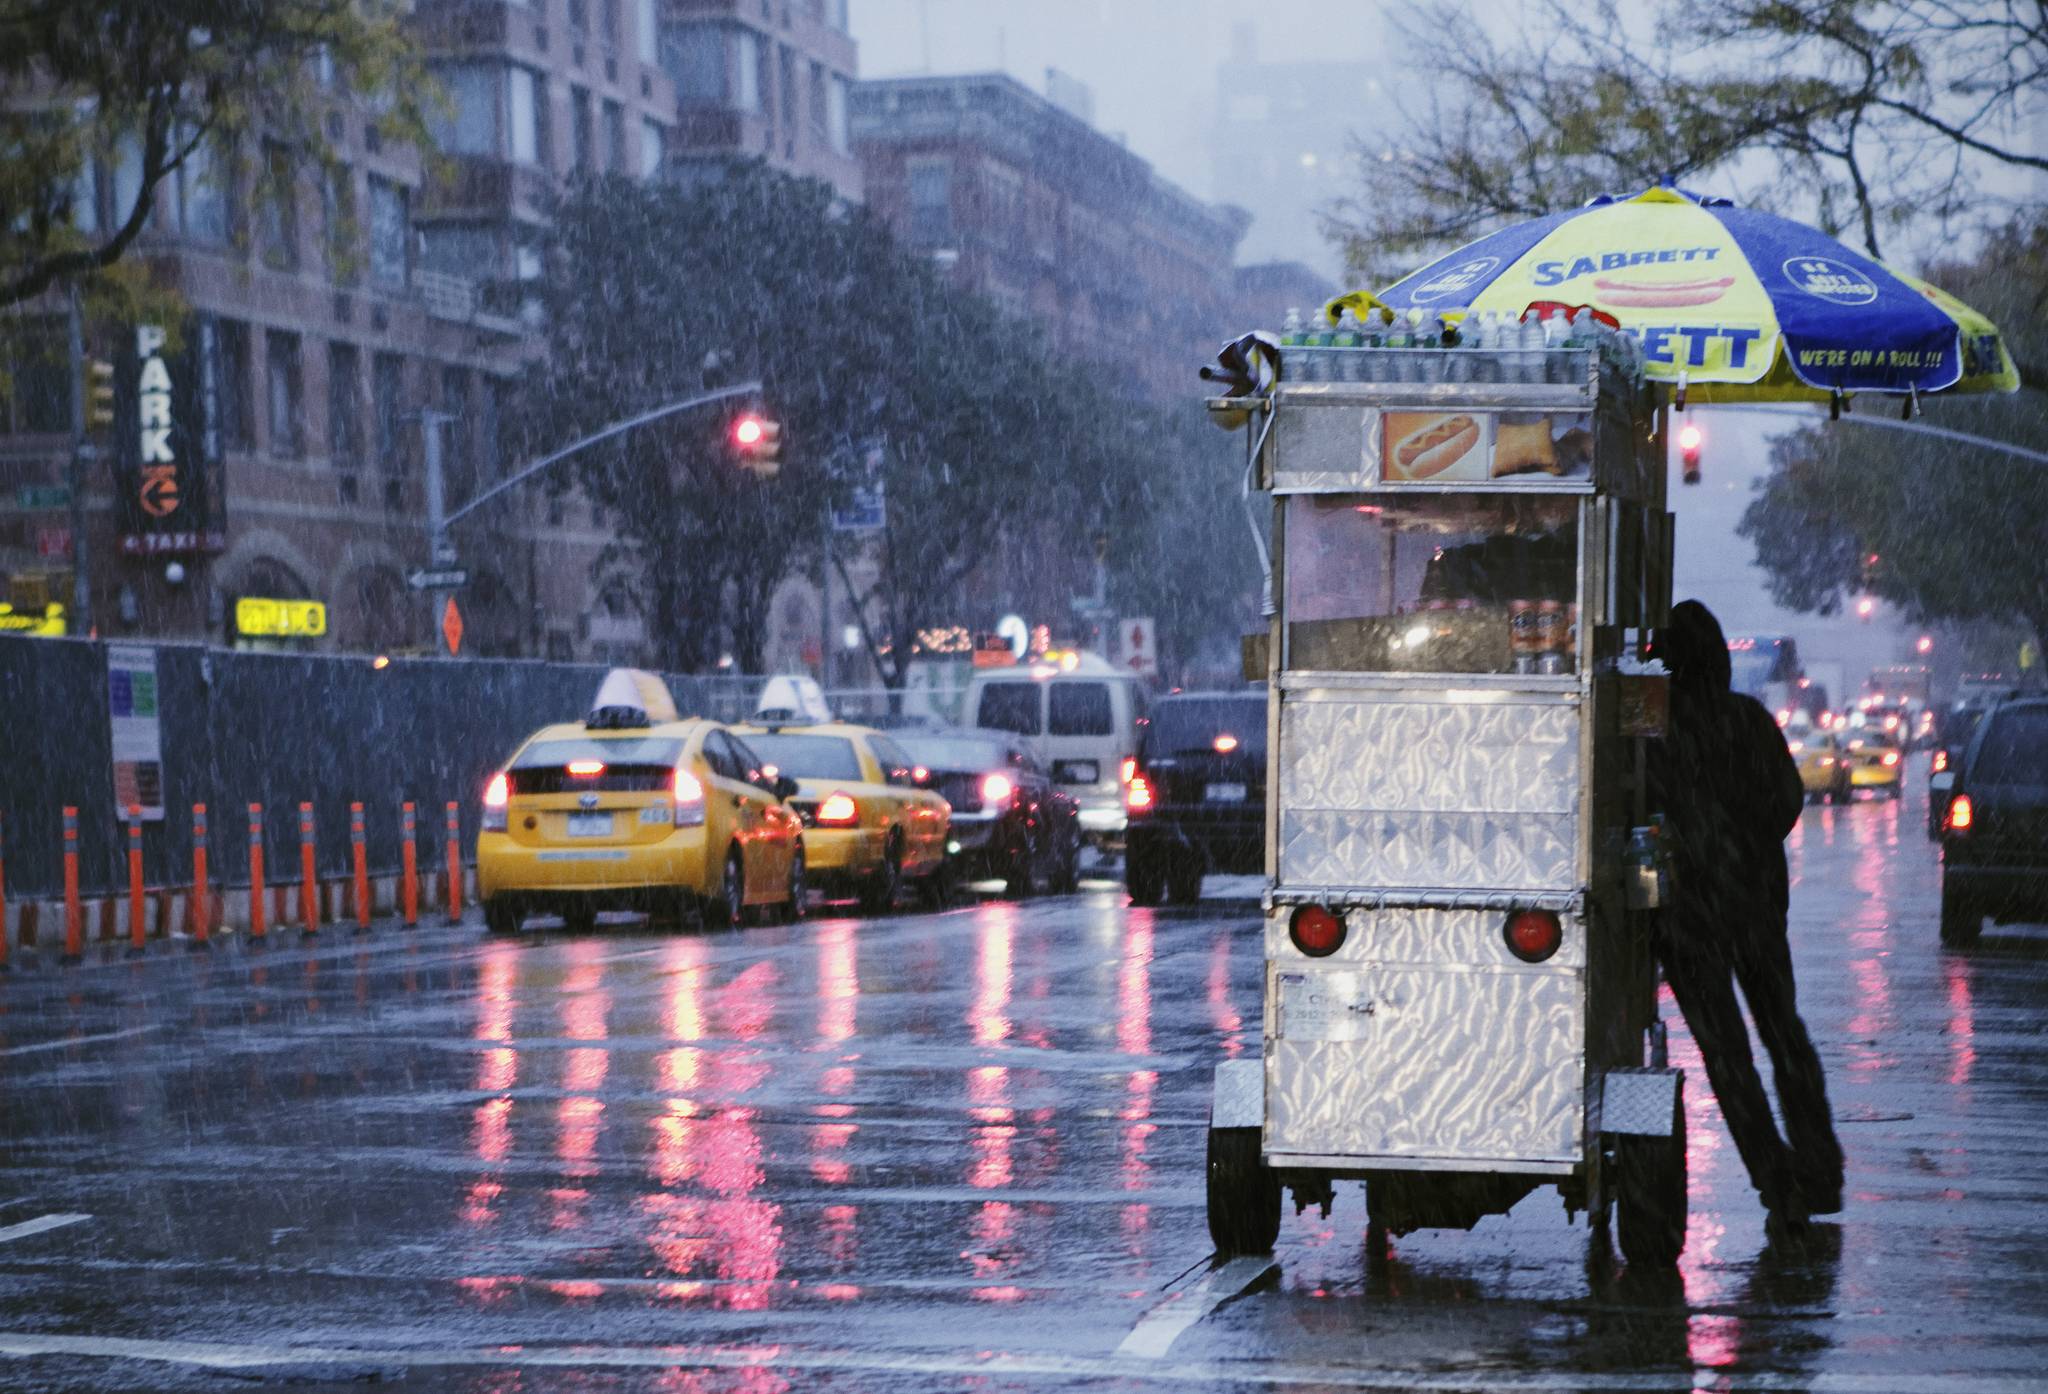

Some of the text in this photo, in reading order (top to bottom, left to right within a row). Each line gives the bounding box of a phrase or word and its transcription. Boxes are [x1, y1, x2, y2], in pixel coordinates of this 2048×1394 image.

[1534, 247, 1720, 286] SABRETT
[1620, 326, 1760, 368] ETT
[1850, 351, 1872, 367] ON
[1875, 351, 1885, 367] A
[1890, 352, 1920, 368] ROLL
[137, 325, 175, 463] PARK
